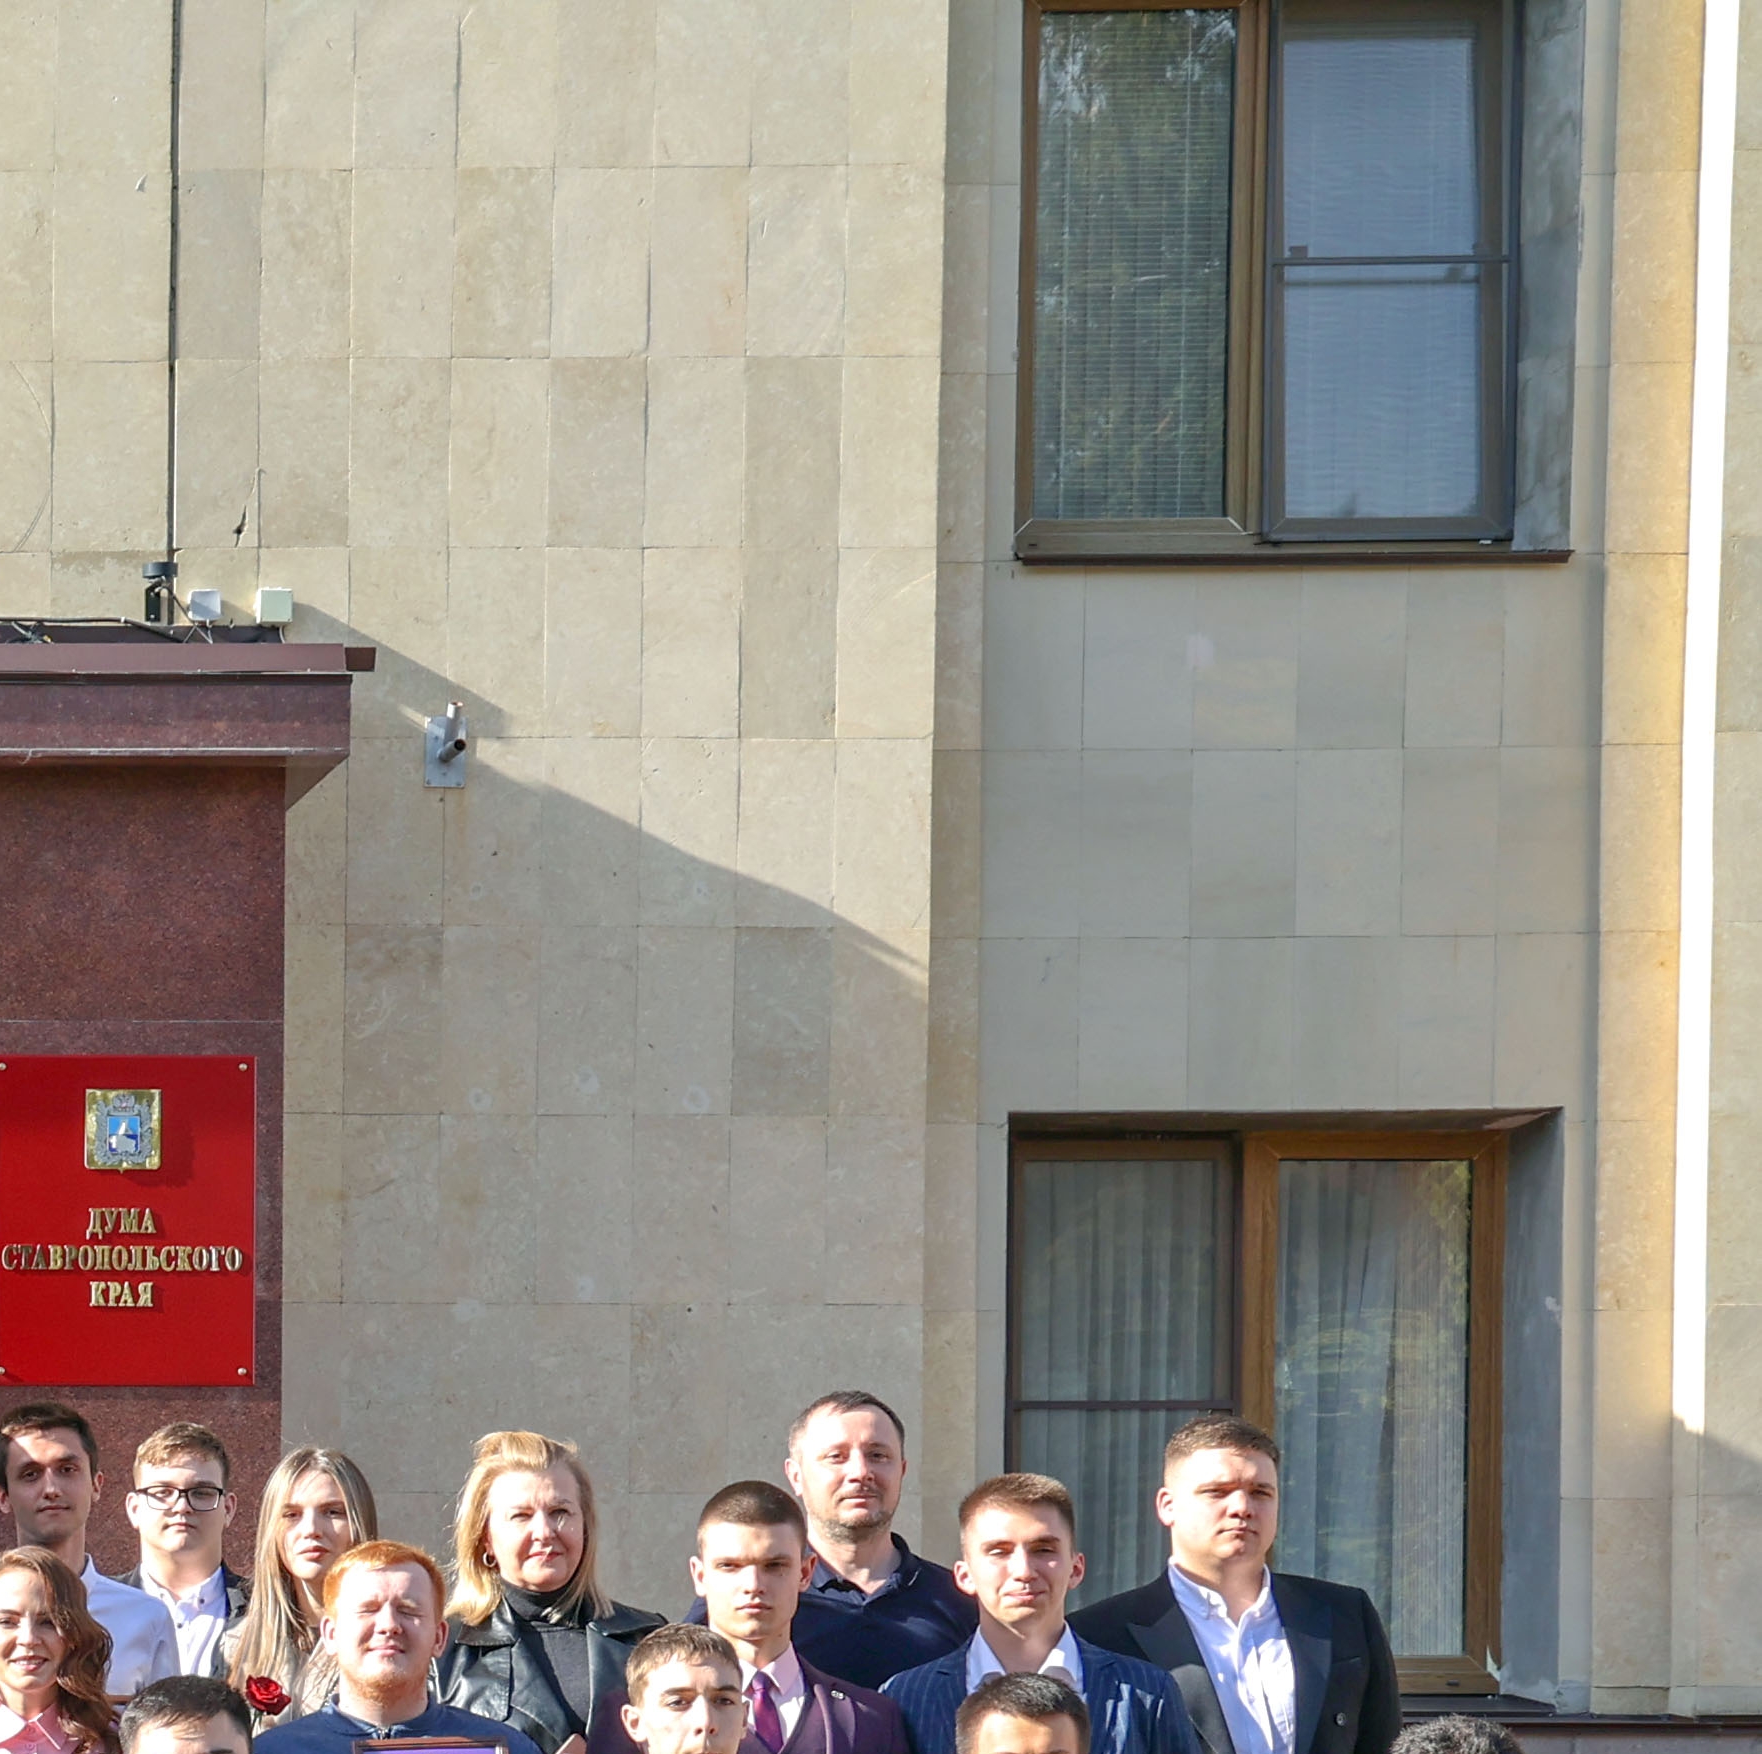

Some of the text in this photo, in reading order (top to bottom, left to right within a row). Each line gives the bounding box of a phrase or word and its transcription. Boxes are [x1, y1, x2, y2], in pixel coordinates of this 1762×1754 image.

[86, 1207, 157, 1240] ДУМА
[1, 1244, 243, 1272] СТАВРОПОЛЬСКОГО
[89, 1281, 153, 1307] КРАЯ
